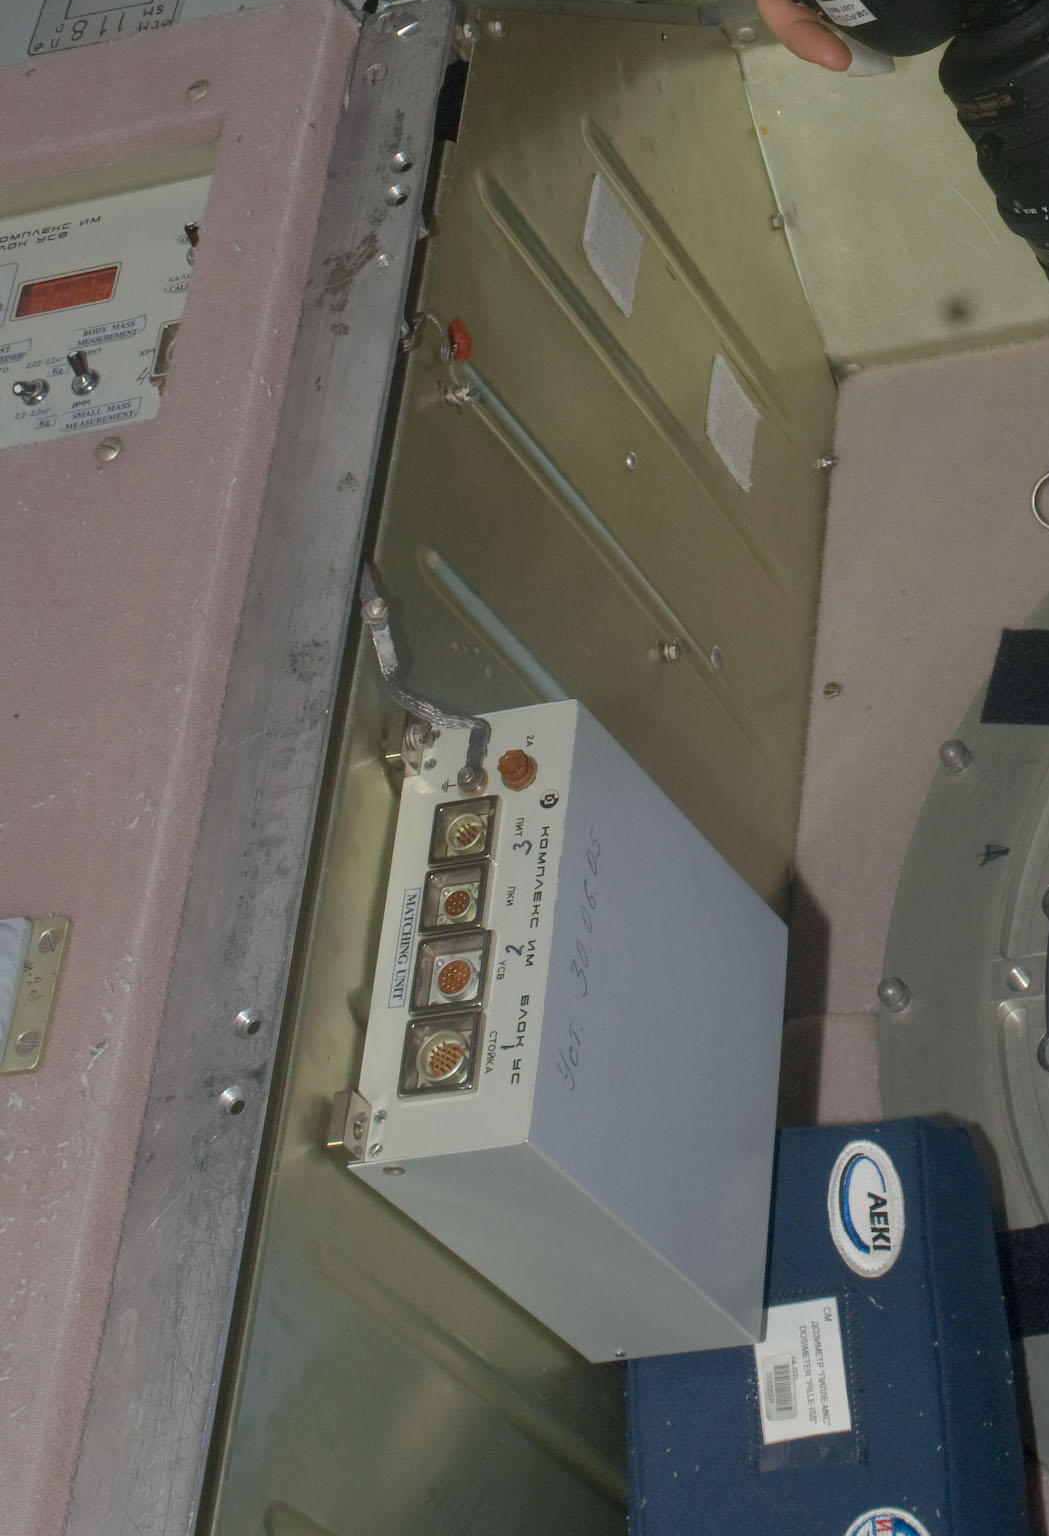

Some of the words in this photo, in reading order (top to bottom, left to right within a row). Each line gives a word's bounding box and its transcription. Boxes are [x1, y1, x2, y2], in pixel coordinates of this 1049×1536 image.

[143, 5, 164, 17] SM
[72, 12, 124, 42] 118
[80, 216, 101, 227] ИМ
[37, 232, 69, 244] УСВ
[77, 329, 138, 347] MEASUREMENT
[83, 326, 106, 337] BODY
[111, 320, 136, 331] MASS
[72, 399, 91, 409] ИММ
[72, 407, 101, 419] SMALL
[107, 402, 132, 412] MASS
[64, 410, 135, 430] MEASUREMENT
[514, 817, 525, 837] ПИТ
[513, 840, 532, 856] 3
[530, 825, 550, 929] КОМПЛЕКС
[506, 886, 516, 906] ПКИ
[398, 894, 417, 965] MATCHING
[505, 944, 524, 956] 2
[525, 939, 537, 967] ИМ
[497, 960, 508, 980] УСВ
[393, 969, 407, 999] UNIT
[515, 995, 529, 1048] БЛОК
[485, 1030, 498, 1074] СТОЙКА
[511, 1058, 522, 1085] УС
[867, 1191, 891, 1252] AEKI
[800, 1325, 812, 1377] DOSIMETER
[811, 1321, 824, 1369] ДОЗИМЕТР
